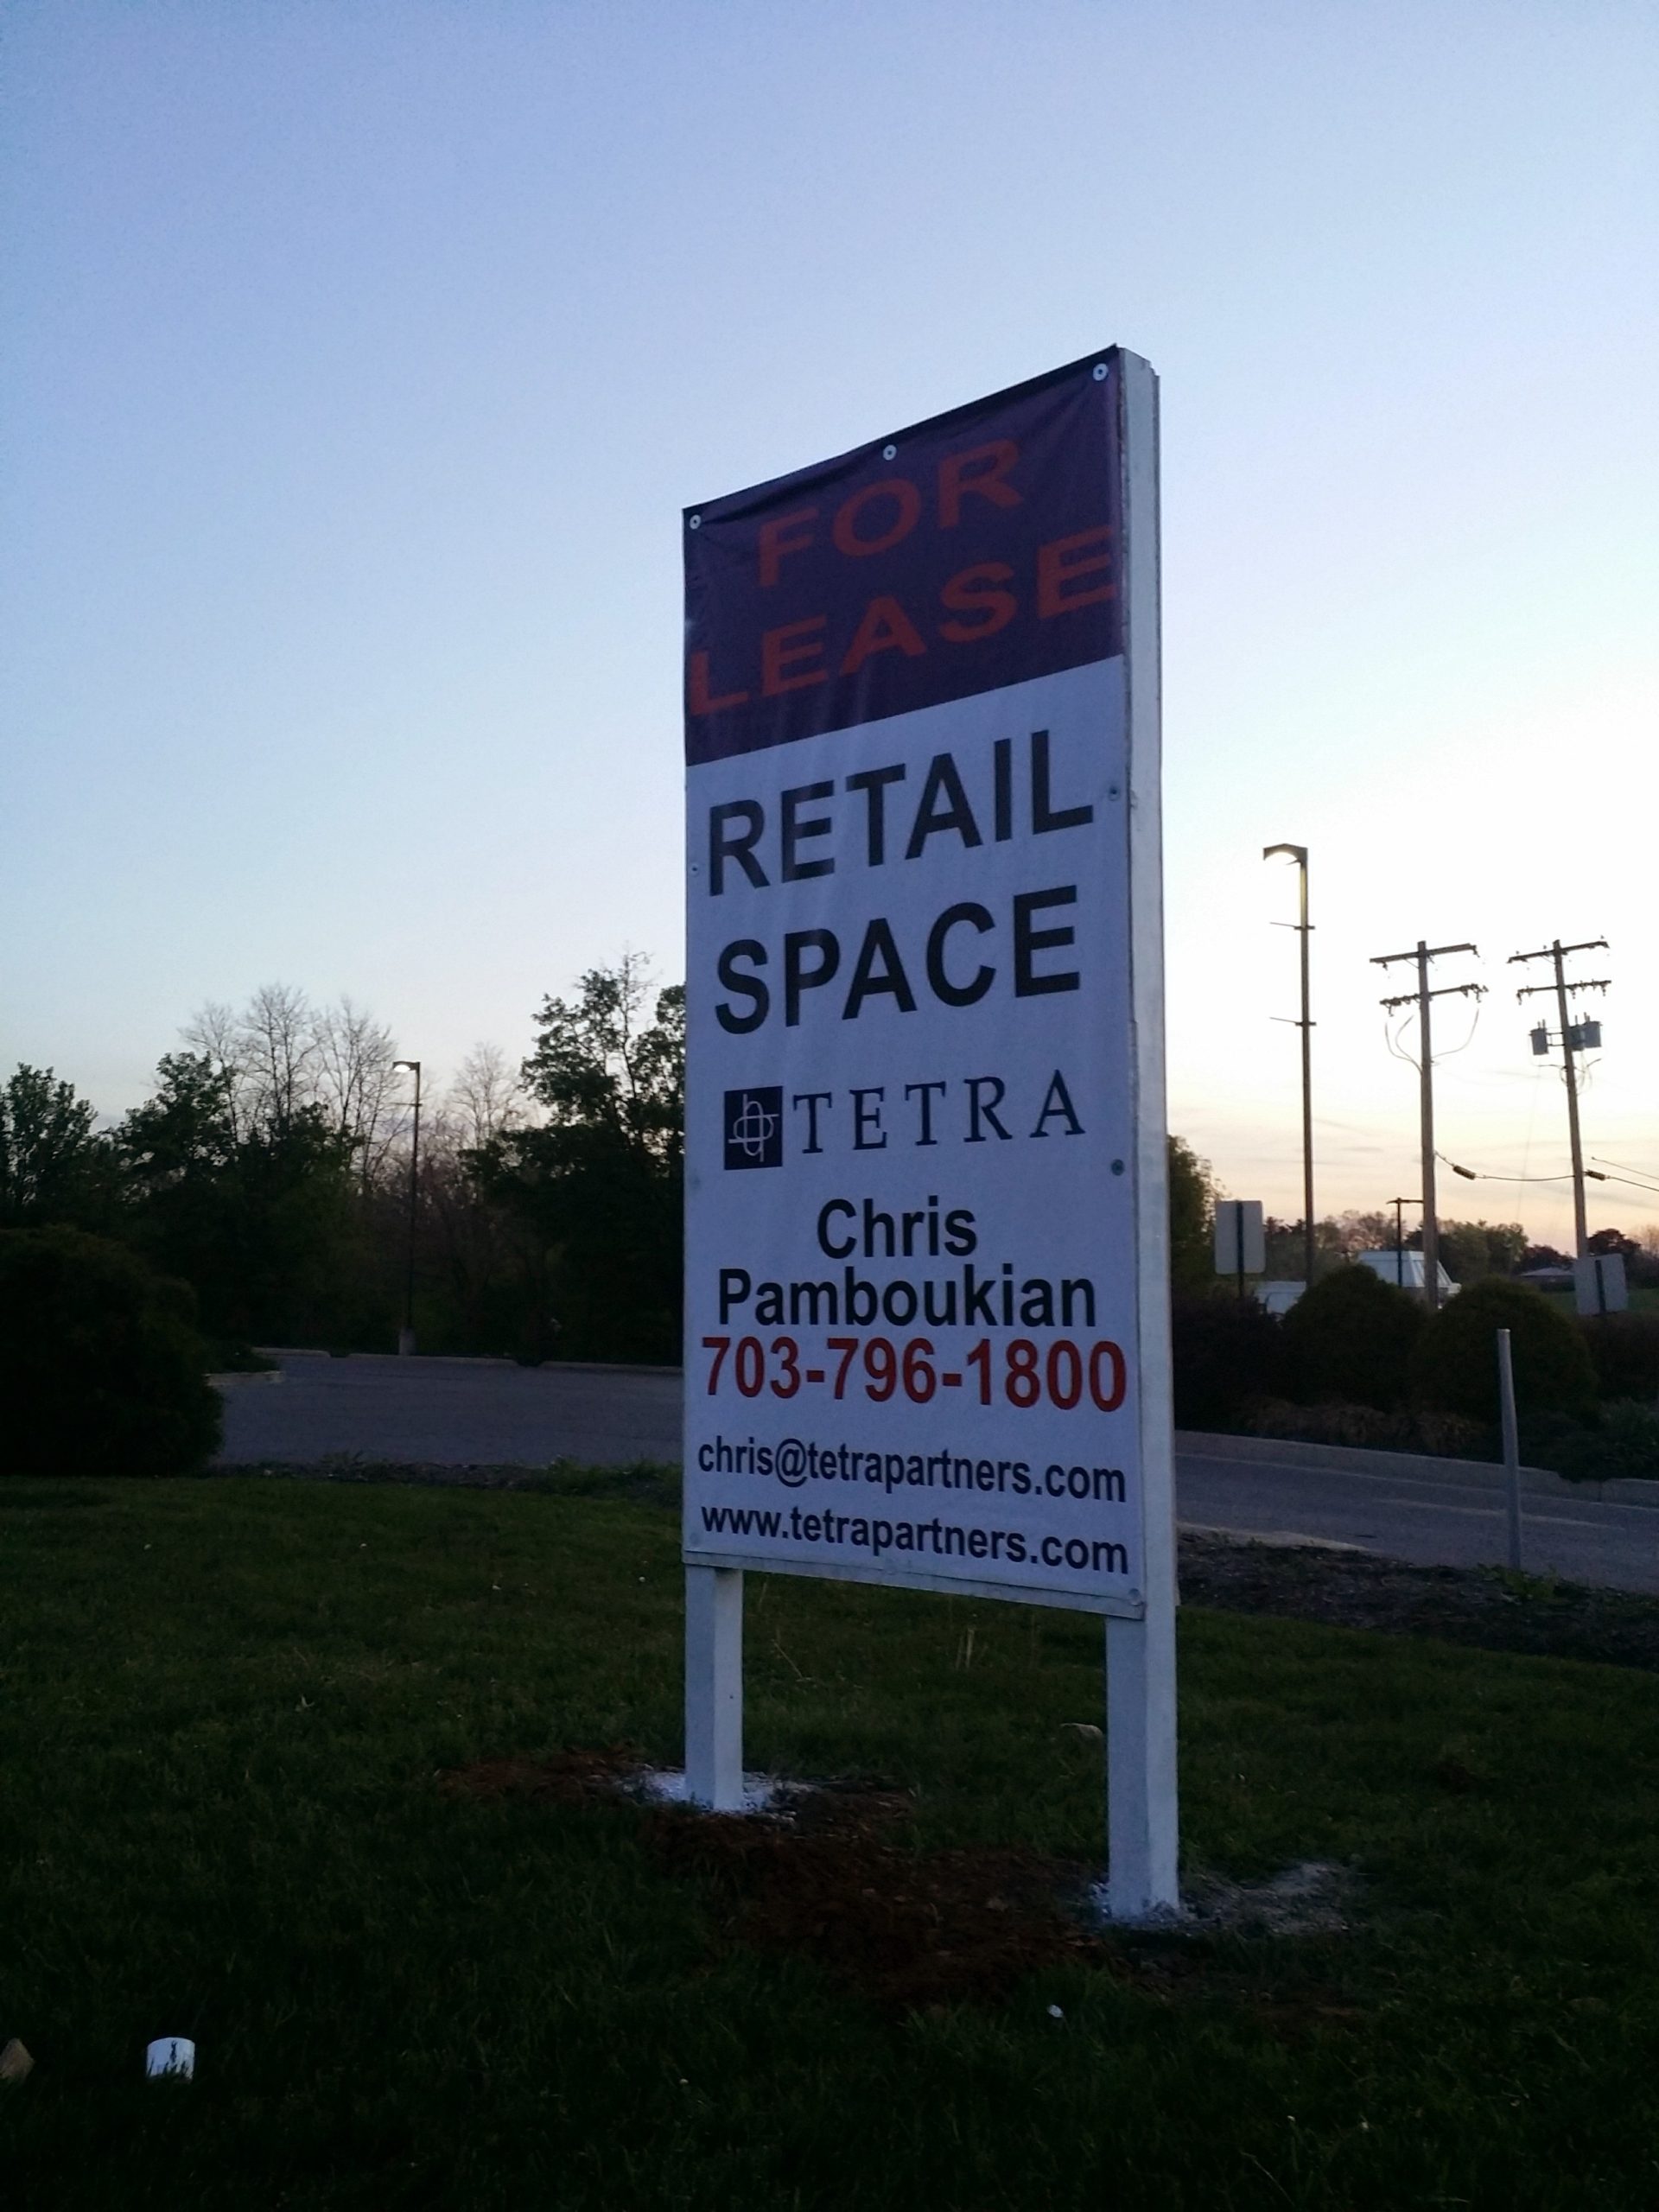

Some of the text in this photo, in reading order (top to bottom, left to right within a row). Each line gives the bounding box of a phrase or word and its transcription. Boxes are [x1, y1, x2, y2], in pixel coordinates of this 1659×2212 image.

[758, 438, 1024, 588] FOR
[689, 524, 1118, 717] LEASE
[709, 729, 1094, 896] RETAIL
[715, 885, 1081, 1034] SPACE
[792, 1069, 1086, 1154] TETRA
[817, 1194, 978, 1259] Chris
[718, 1263, 1096, 1327] Pamboukian
[701, 1336, 1128, 1413] 703-796-1800
[697, 1435, 1127, 1503] chris@tetrapartners.com
[701, 1506, 1129, 1574] www.tetrapartners.com
